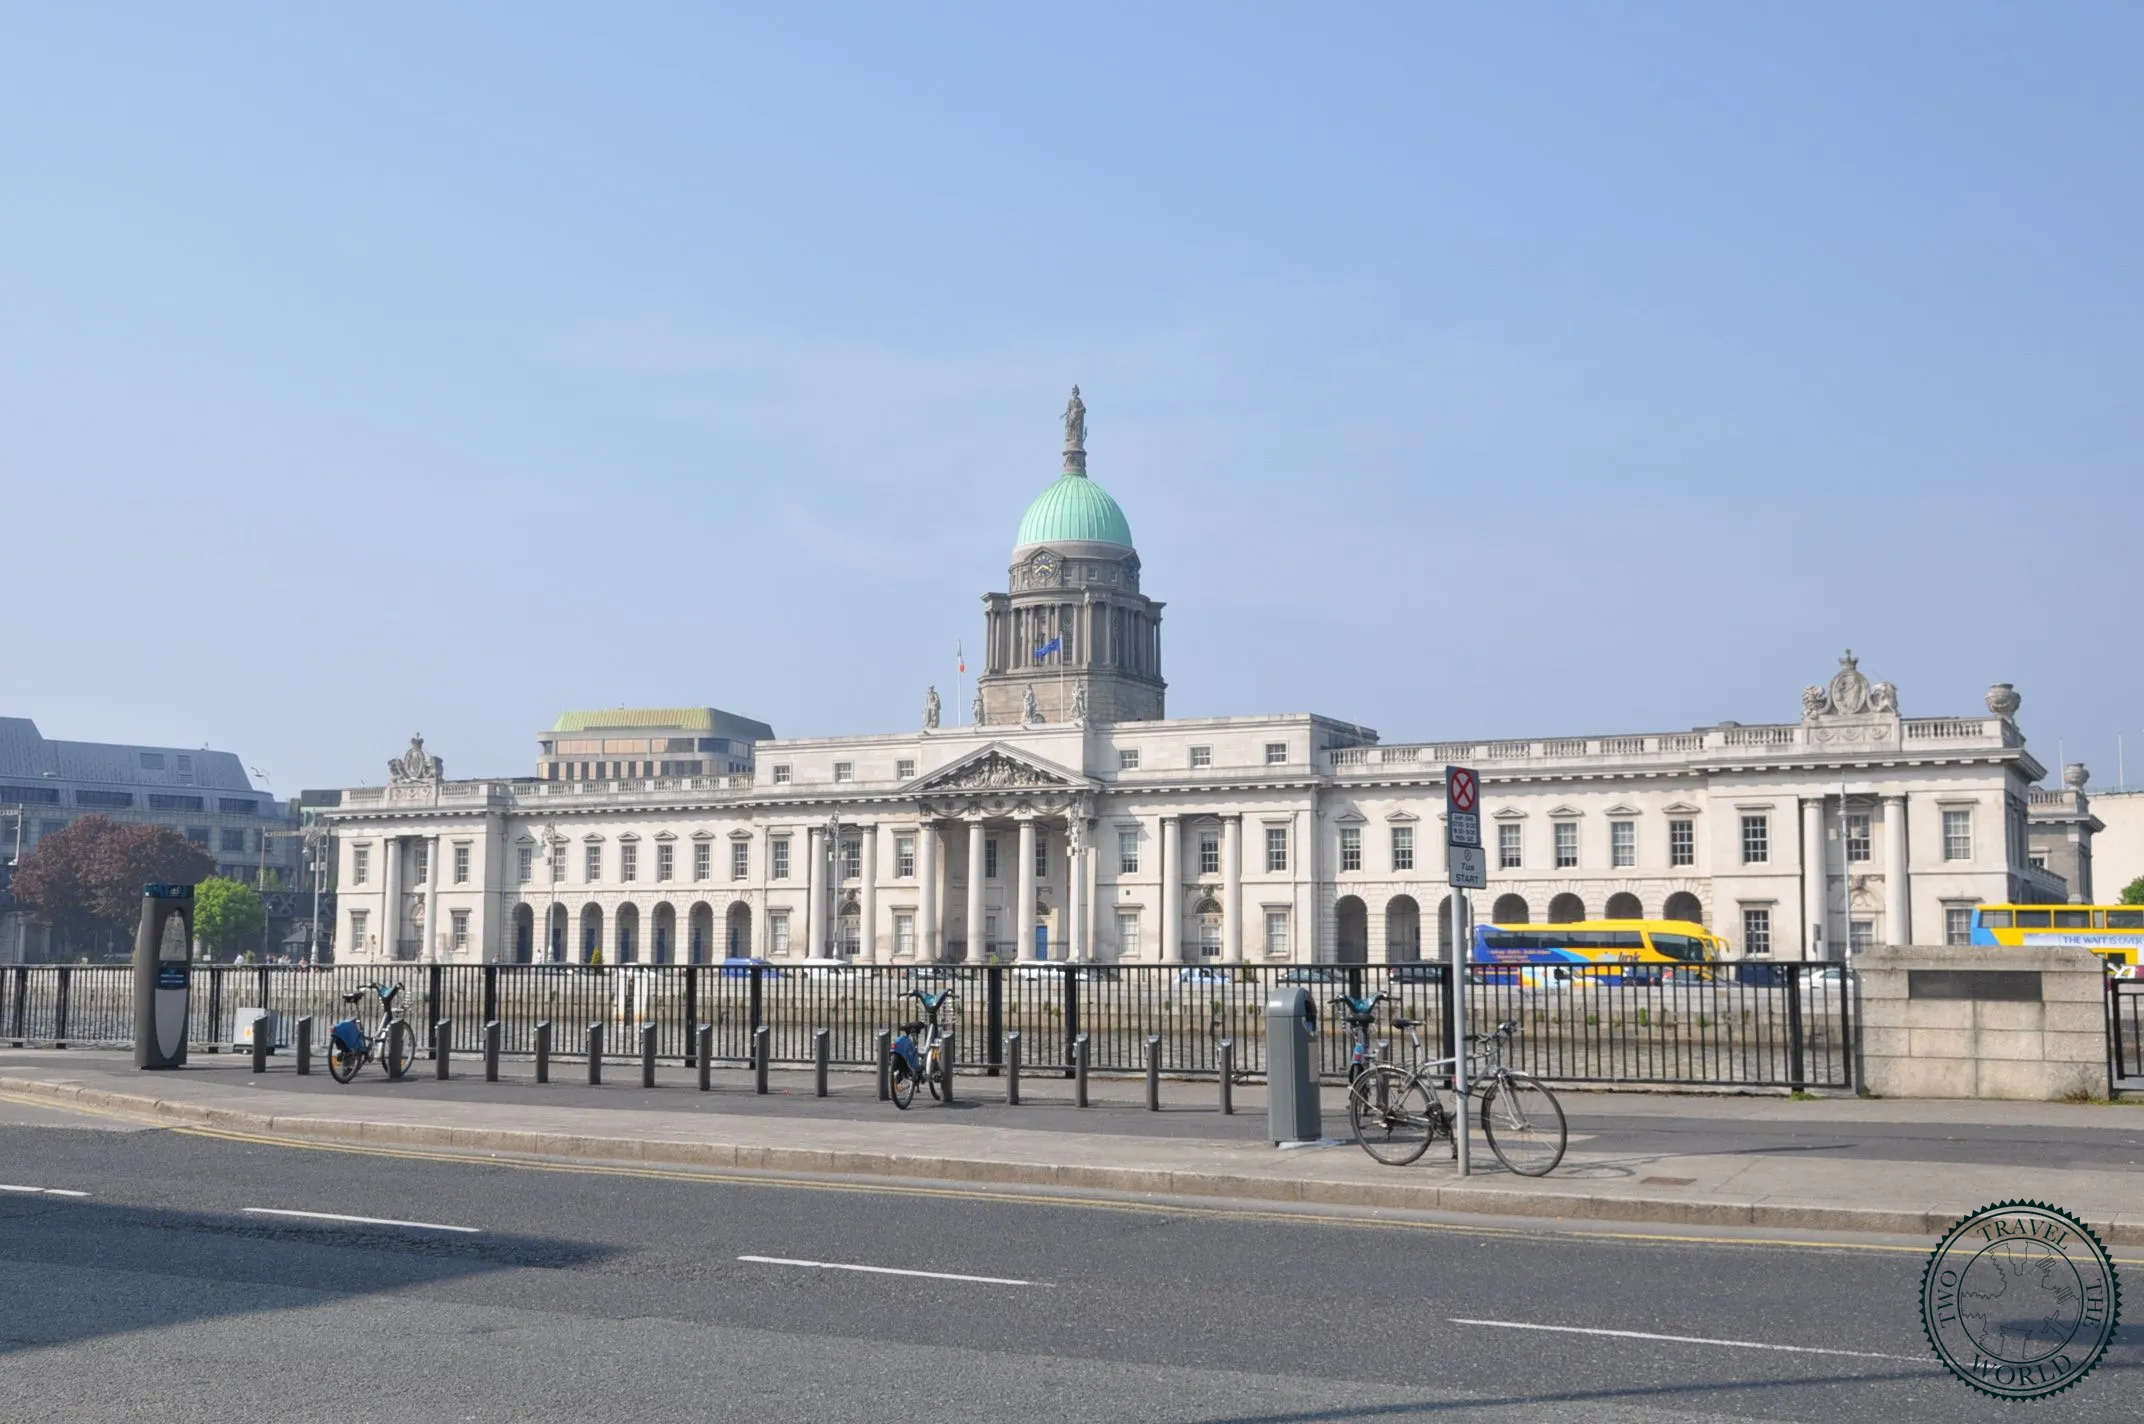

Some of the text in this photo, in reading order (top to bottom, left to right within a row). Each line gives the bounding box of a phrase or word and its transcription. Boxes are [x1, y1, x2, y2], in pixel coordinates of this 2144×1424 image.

[1461, 863, 1475, 871] Tus
[1455, 874, 1480, 884] START
[2063, 935, 2144, 944] THE WAIT IS OVER
